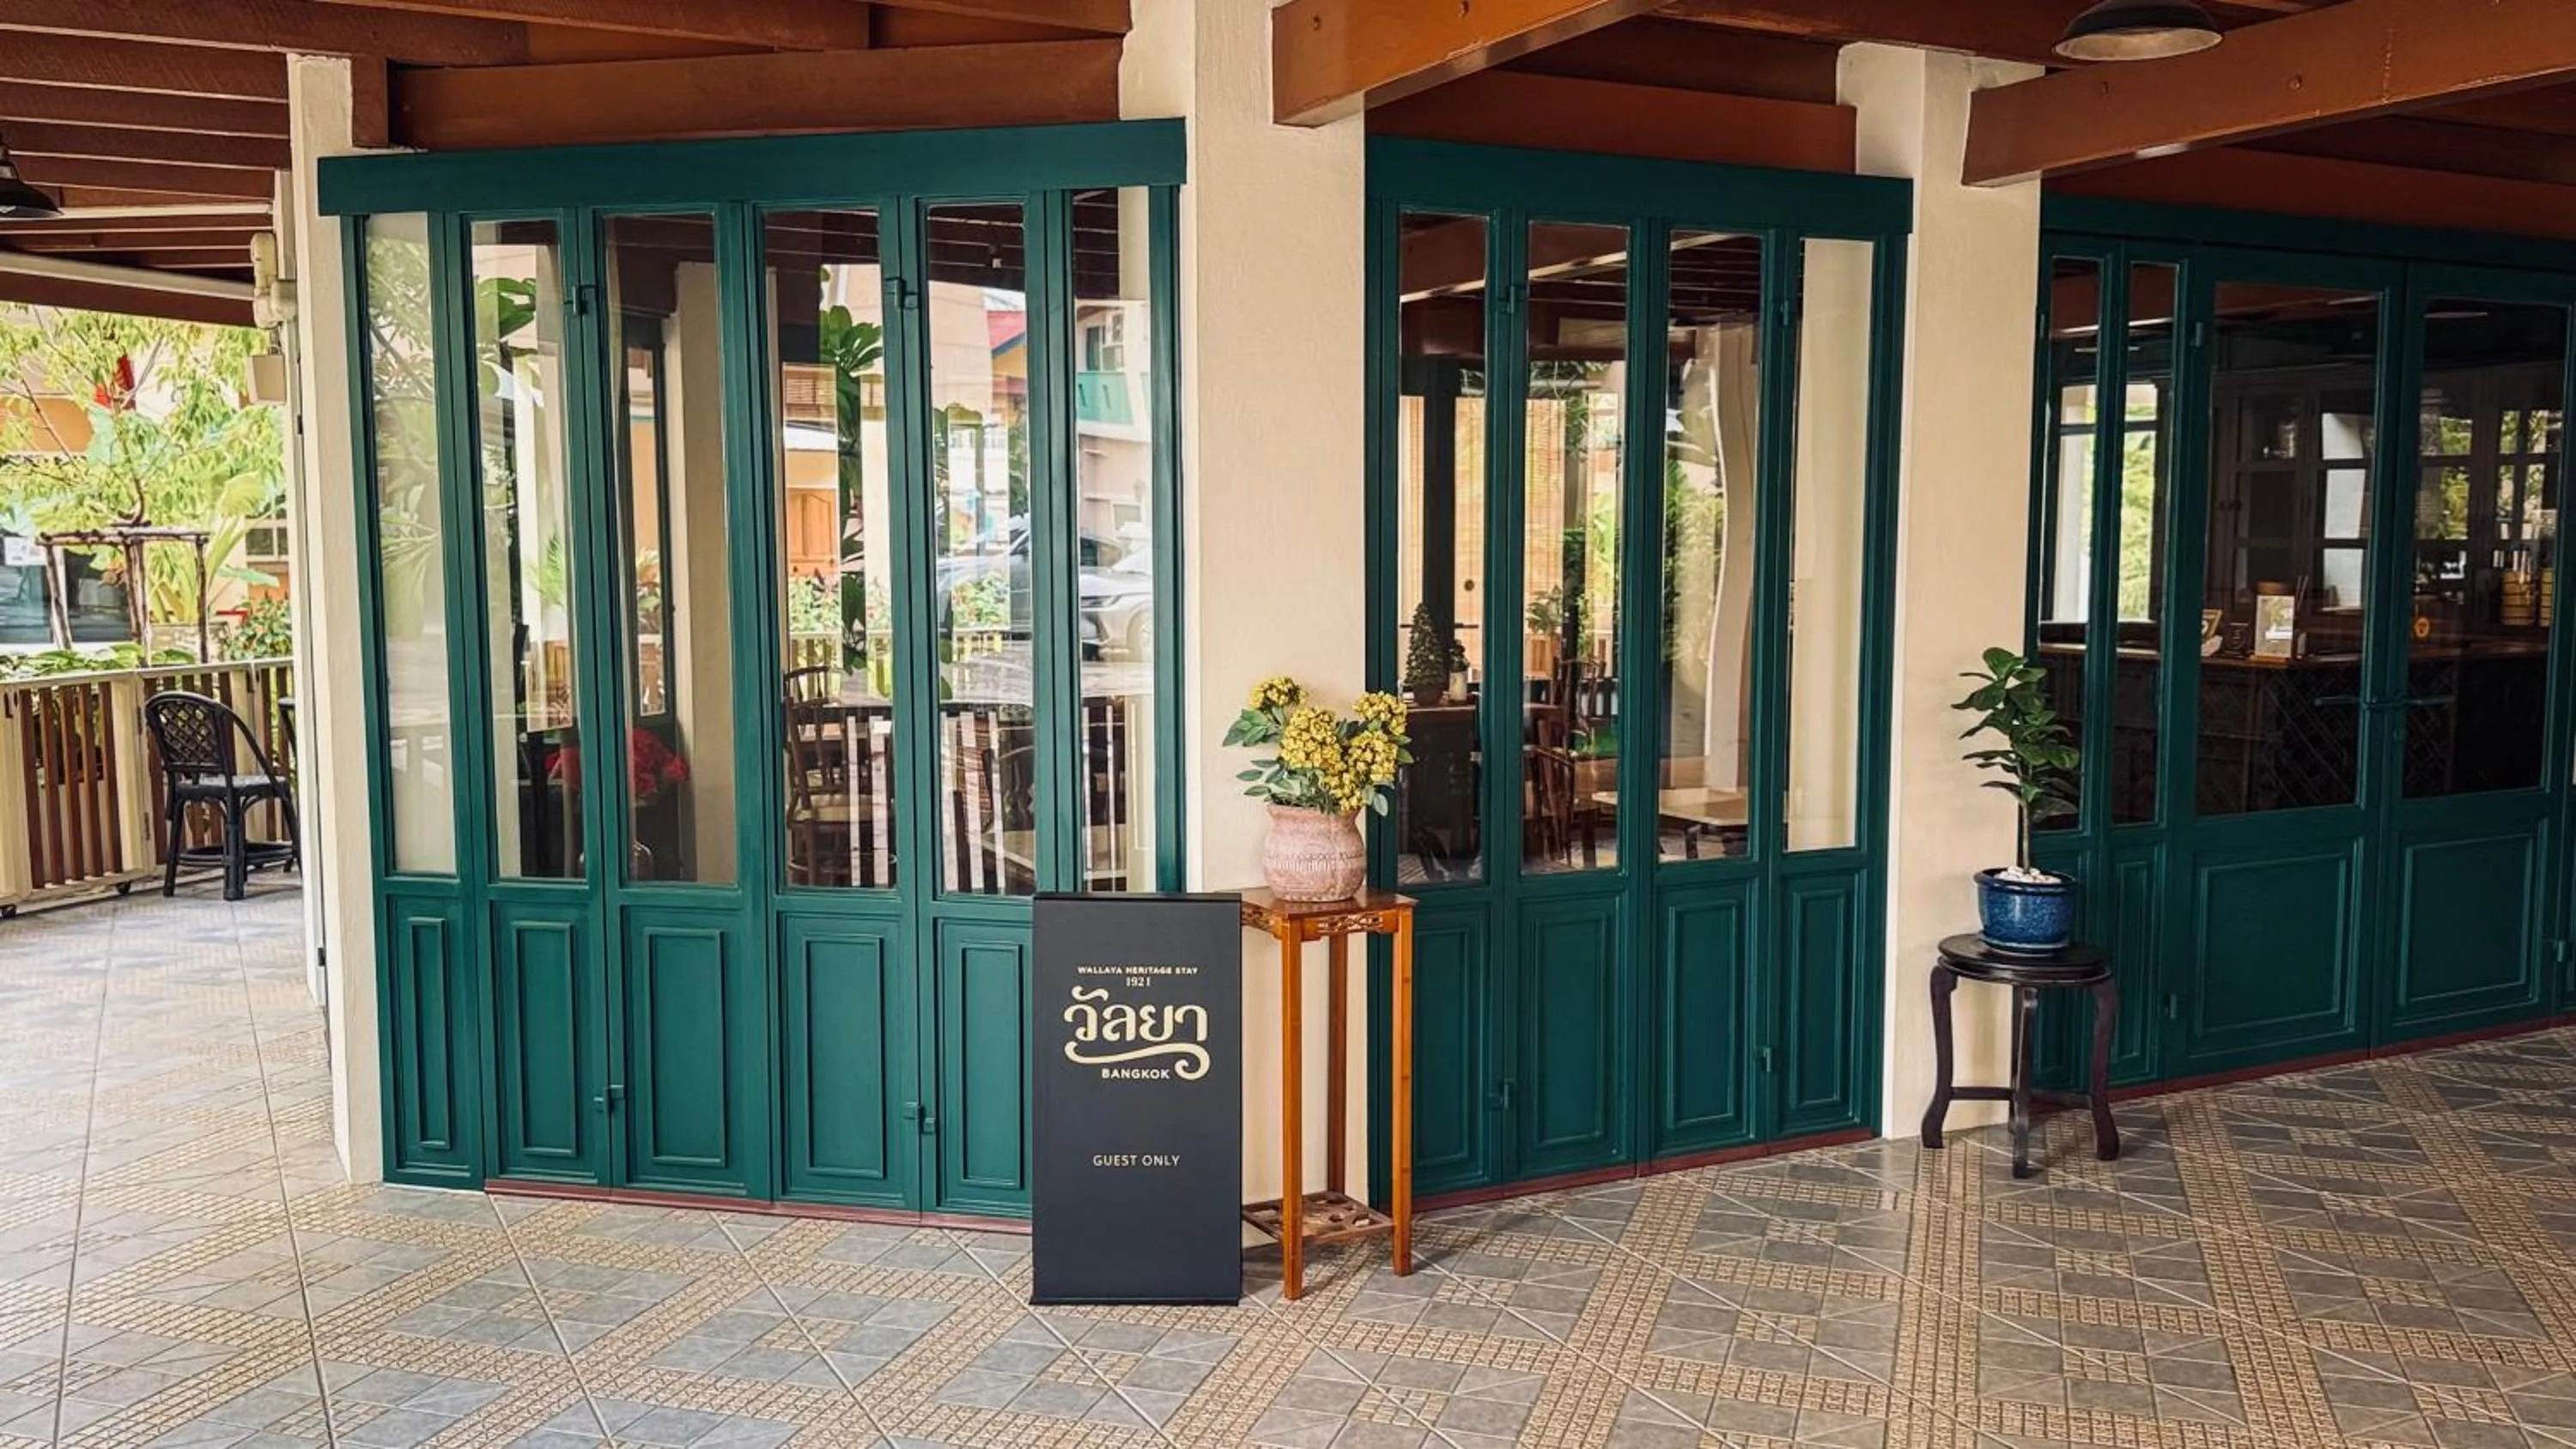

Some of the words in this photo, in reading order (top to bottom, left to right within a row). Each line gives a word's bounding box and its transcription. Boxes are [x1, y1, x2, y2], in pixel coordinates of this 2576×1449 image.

[1077, 966, 1123, 975] WALLAYA
[1125, 966, 1173, 975] HERITAGE
[1175, 966, 1199, 975] STAY
[1126, 976, 1151, 987] 1921
[1063, 985, 1210, 1042] วัลยา
[1101, 1068, 1171, 1080] BANGKOK
[1092, 1155, 1138, 1167] GUEST
[1141, 1155, 1181, 1167] ONLY
